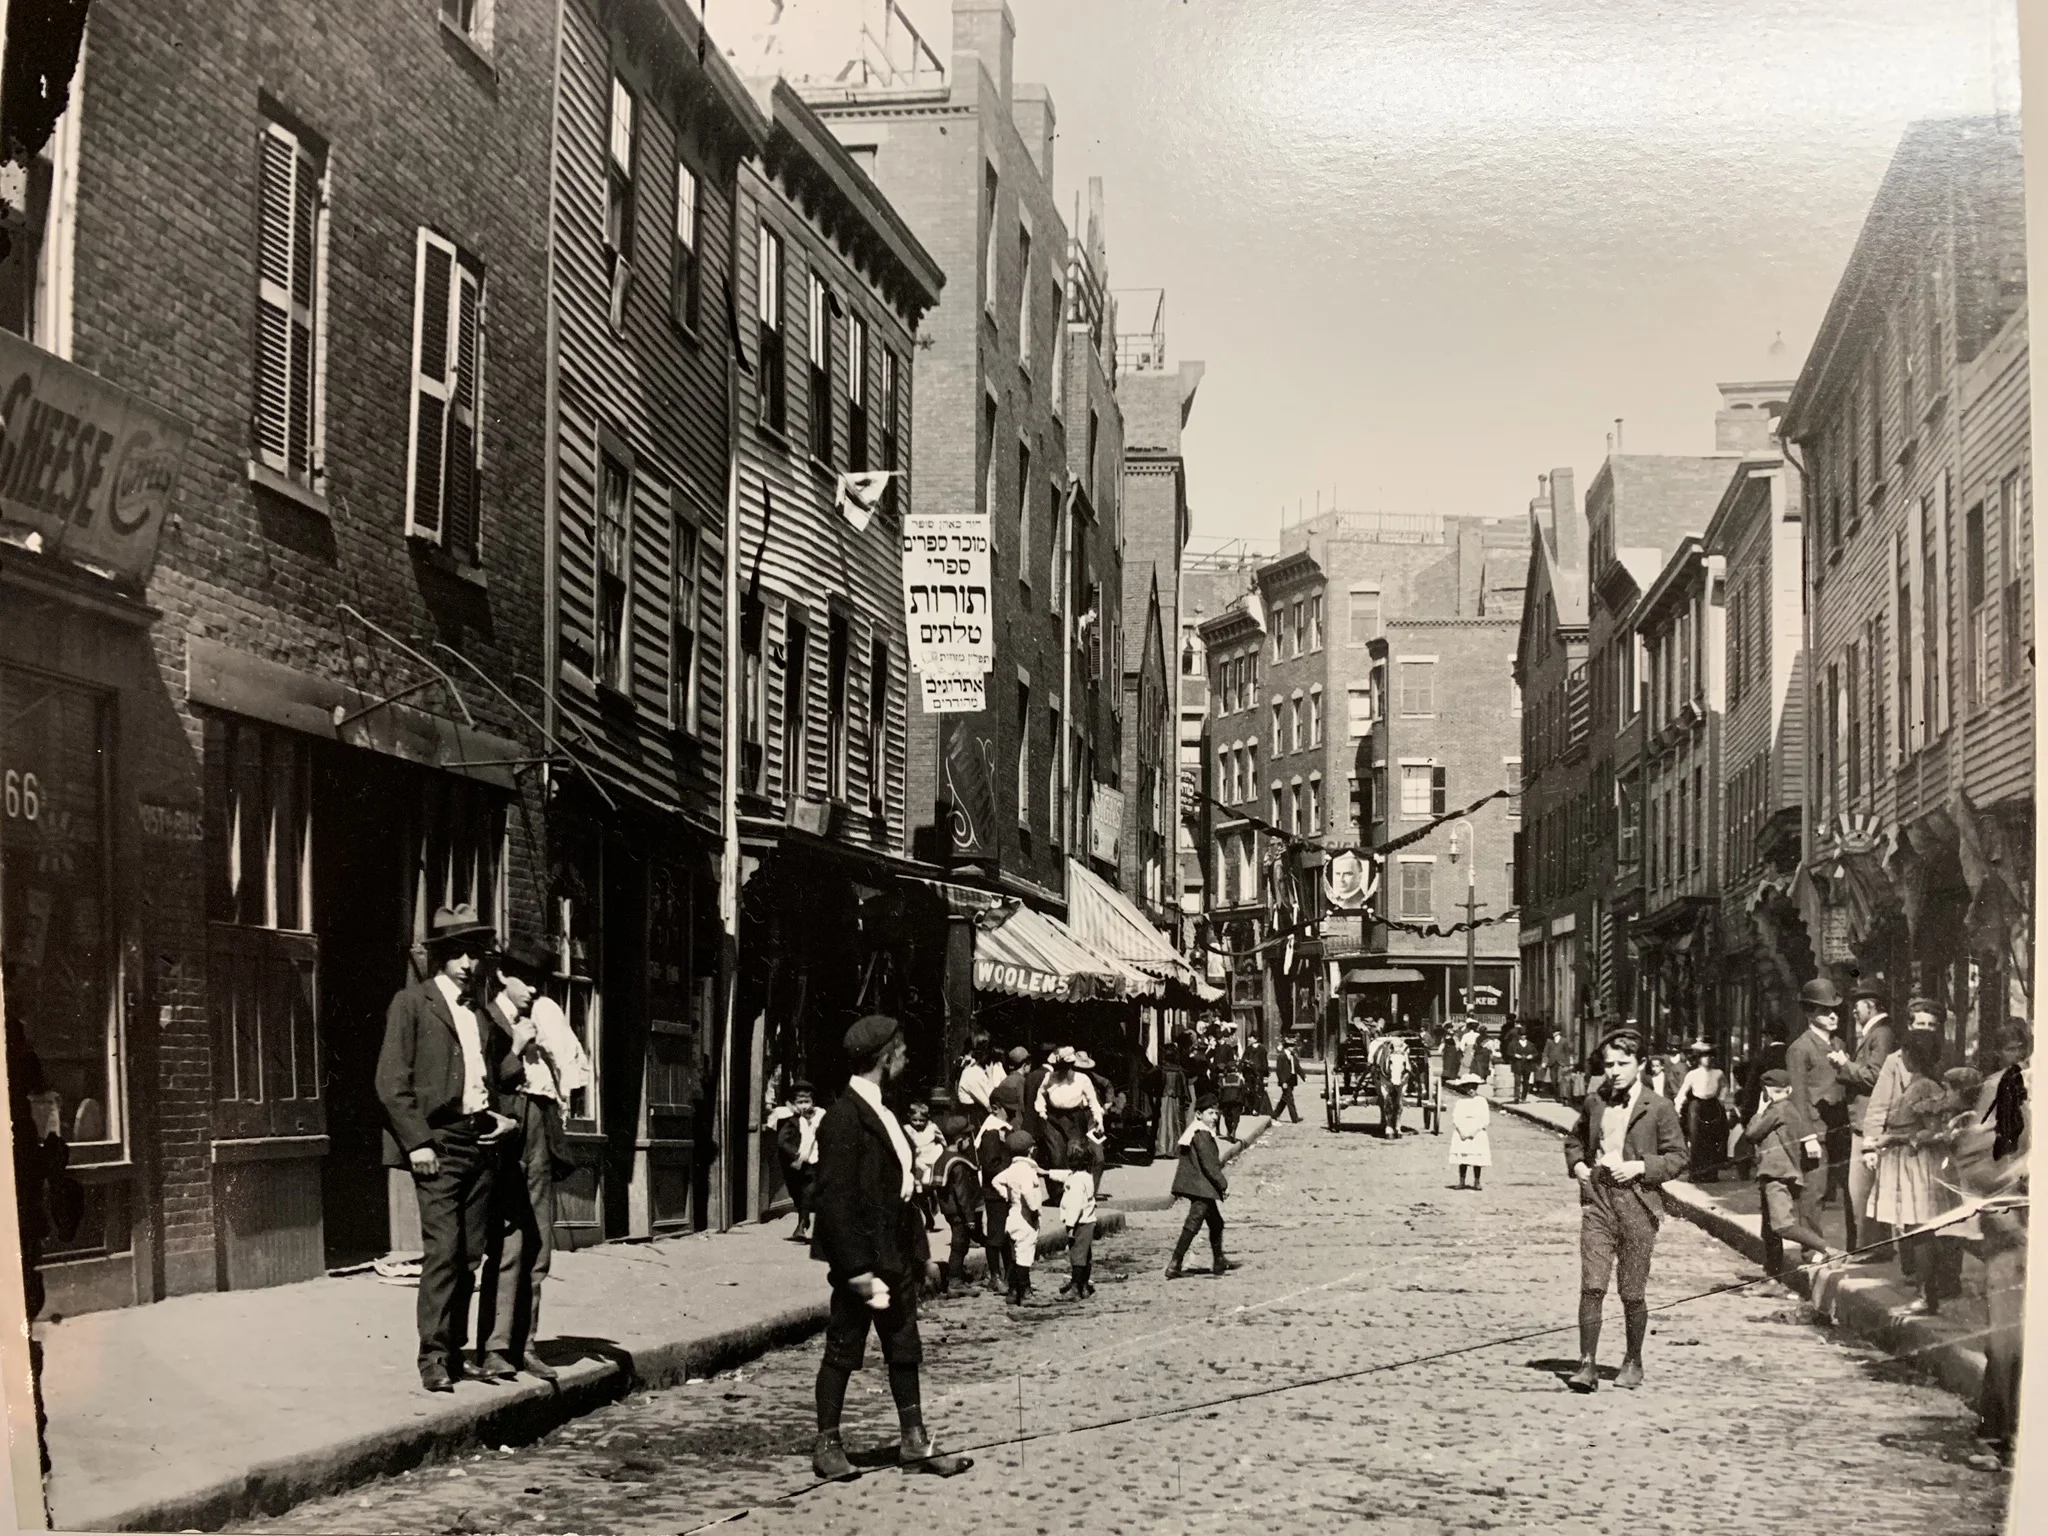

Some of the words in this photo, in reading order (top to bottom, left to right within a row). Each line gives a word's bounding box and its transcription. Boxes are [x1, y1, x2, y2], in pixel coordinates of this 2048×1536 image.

[902, 535, 947, 552] ספרים
[951, 535, 987, 552] מוכר
[926, 558, 971, 574] ספרי
[909, 584, 986, 614] תורות
[920, 616, 982, 644] טלתים
[5, 769, 39, 820] 66
[1094, 790, 1122, 830] SIGNS
